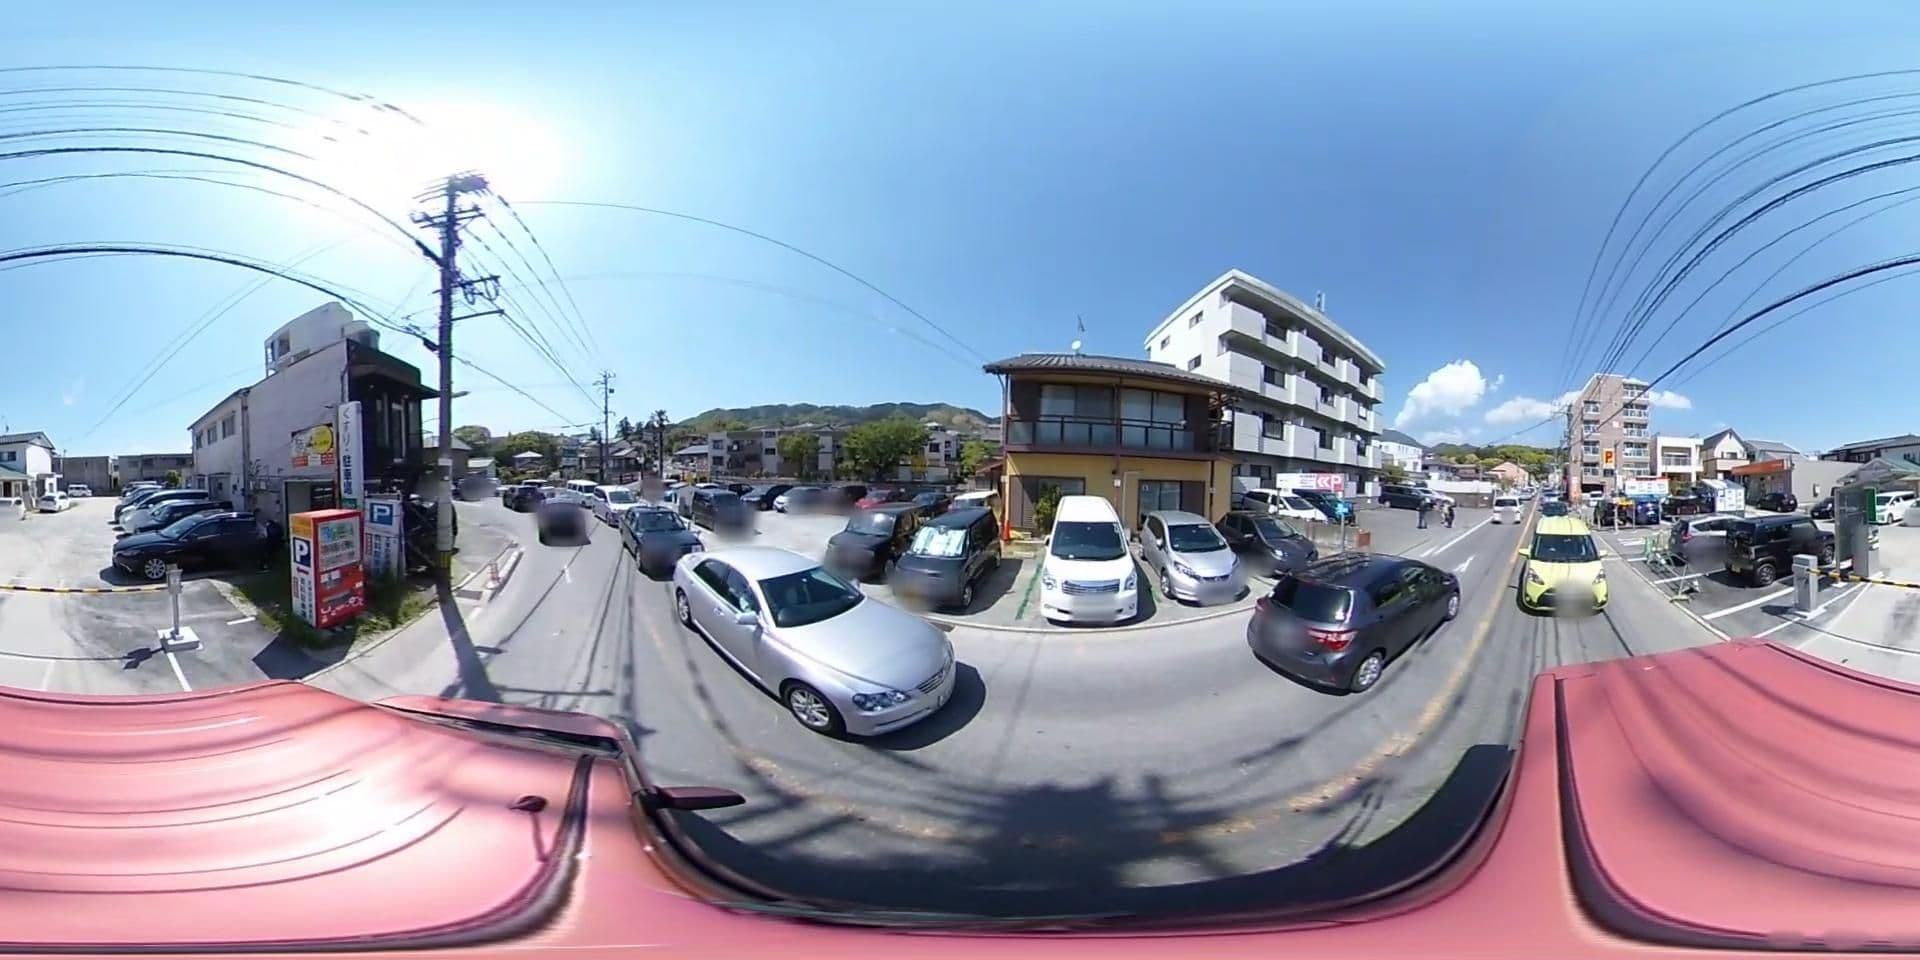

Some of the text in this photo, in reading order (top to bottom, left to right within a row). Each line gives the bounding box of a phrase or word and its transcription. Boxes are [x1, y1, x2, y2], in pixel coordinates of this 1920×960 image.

[1605, 451, 1613, 464] P
[1331, 475, 1341, 493] P
[373, 504, 390, 521] P
[295, 539, 309, 563] P
